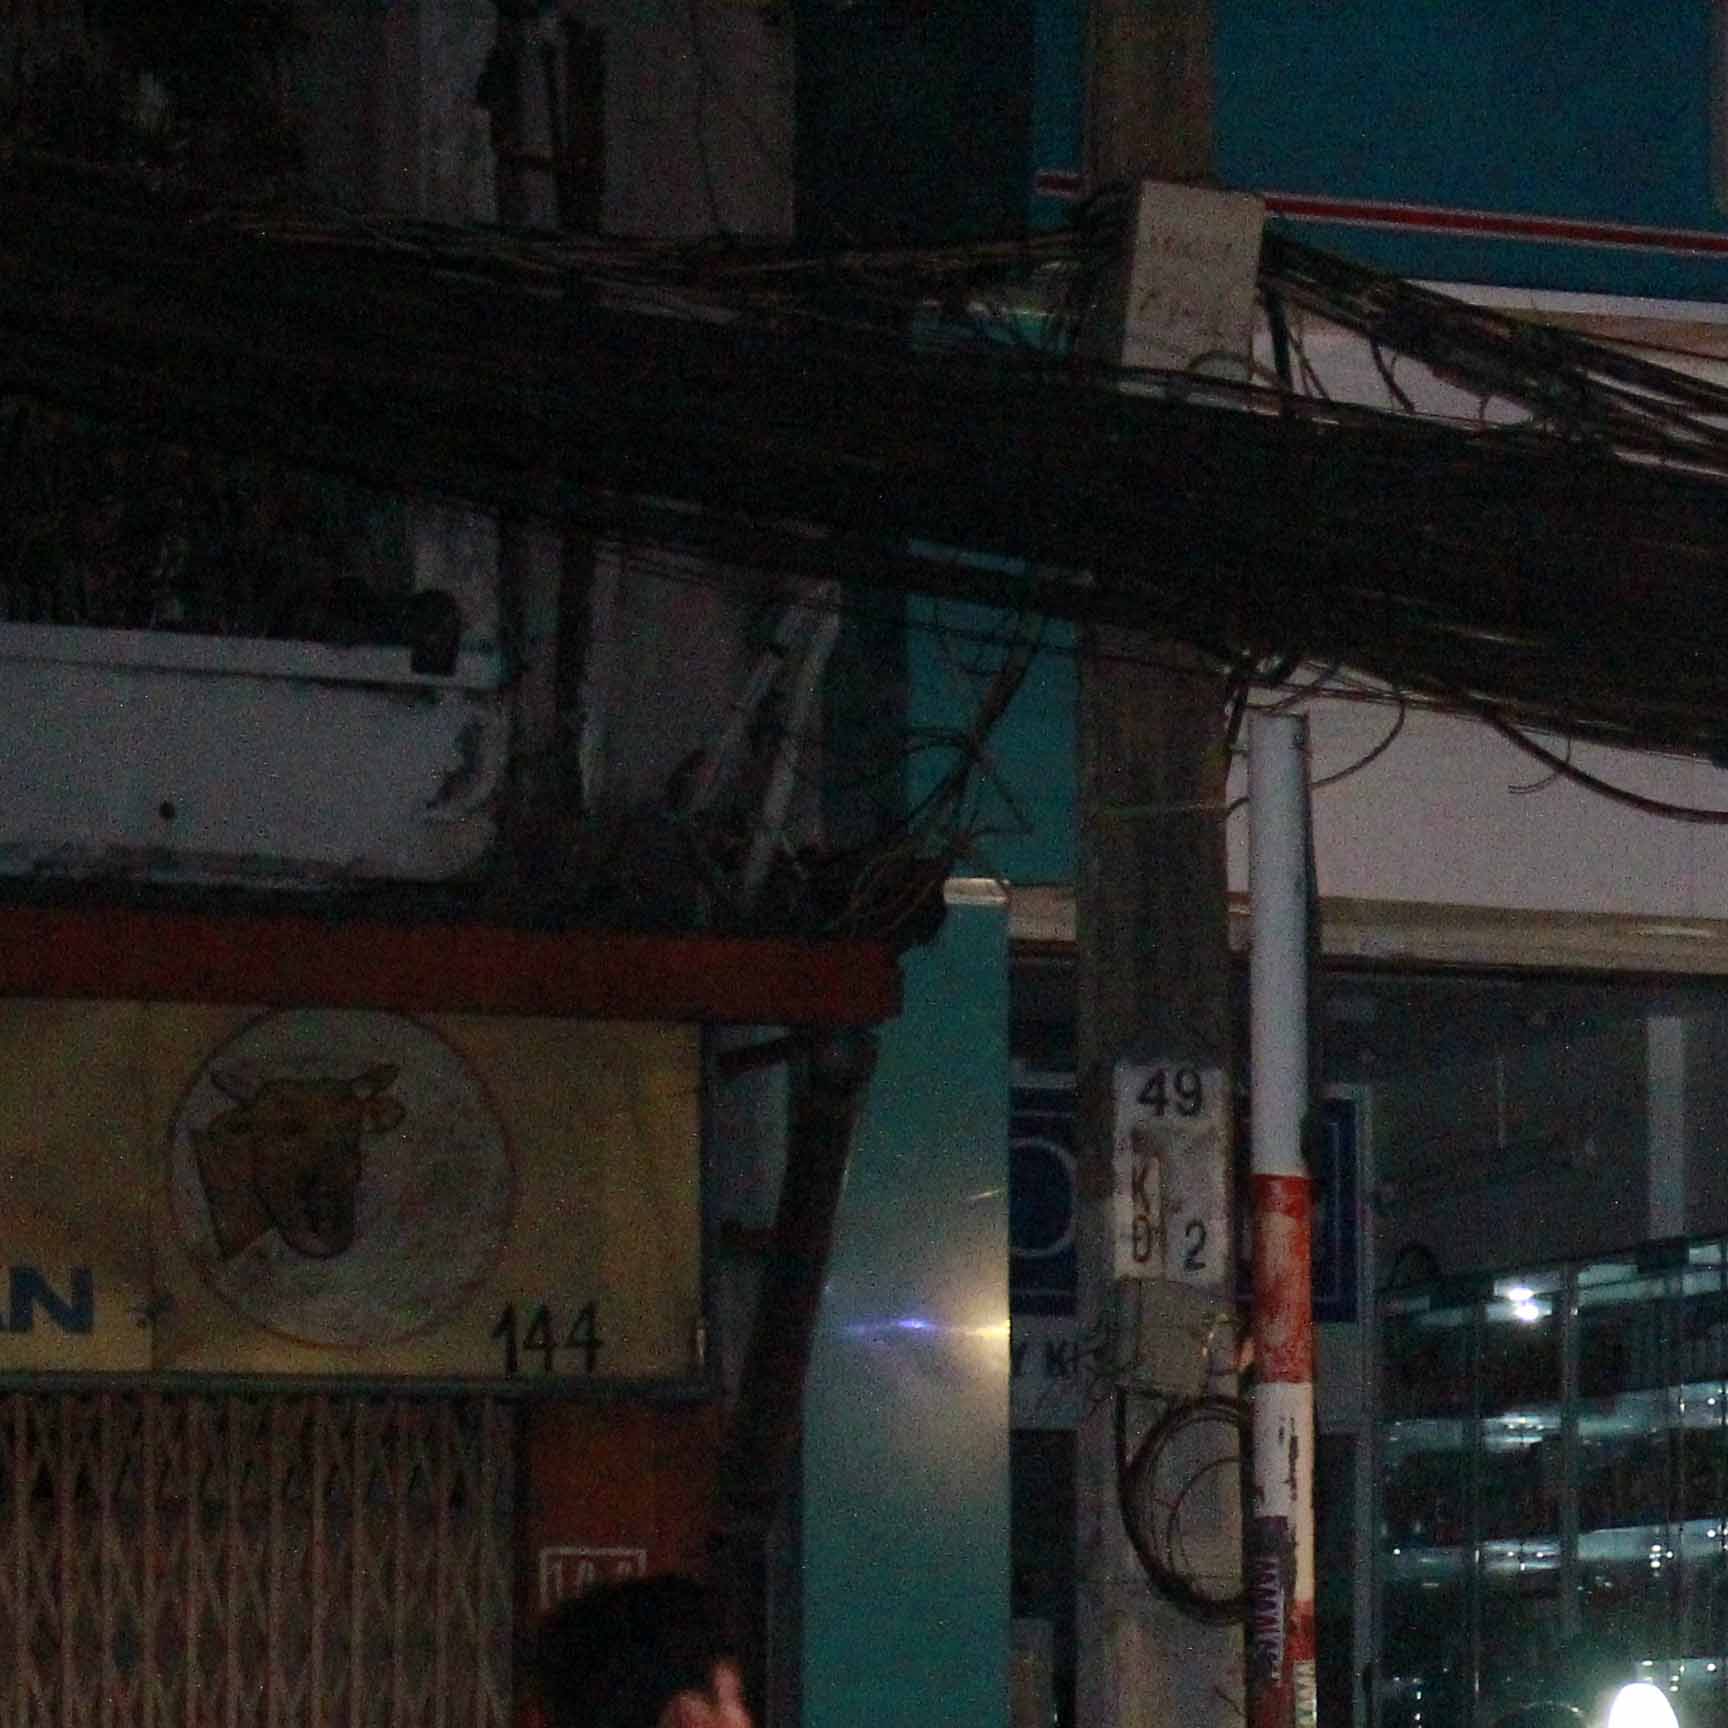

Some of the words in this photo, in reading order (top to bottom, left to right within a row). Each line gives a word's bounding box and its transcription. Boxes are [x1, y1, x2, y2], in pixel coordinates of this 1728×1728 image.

[1138, 1067, 1202, 1117] 49
[0, 1265, 94, 1334] N
[493, 1301, 605, 1373] 144
